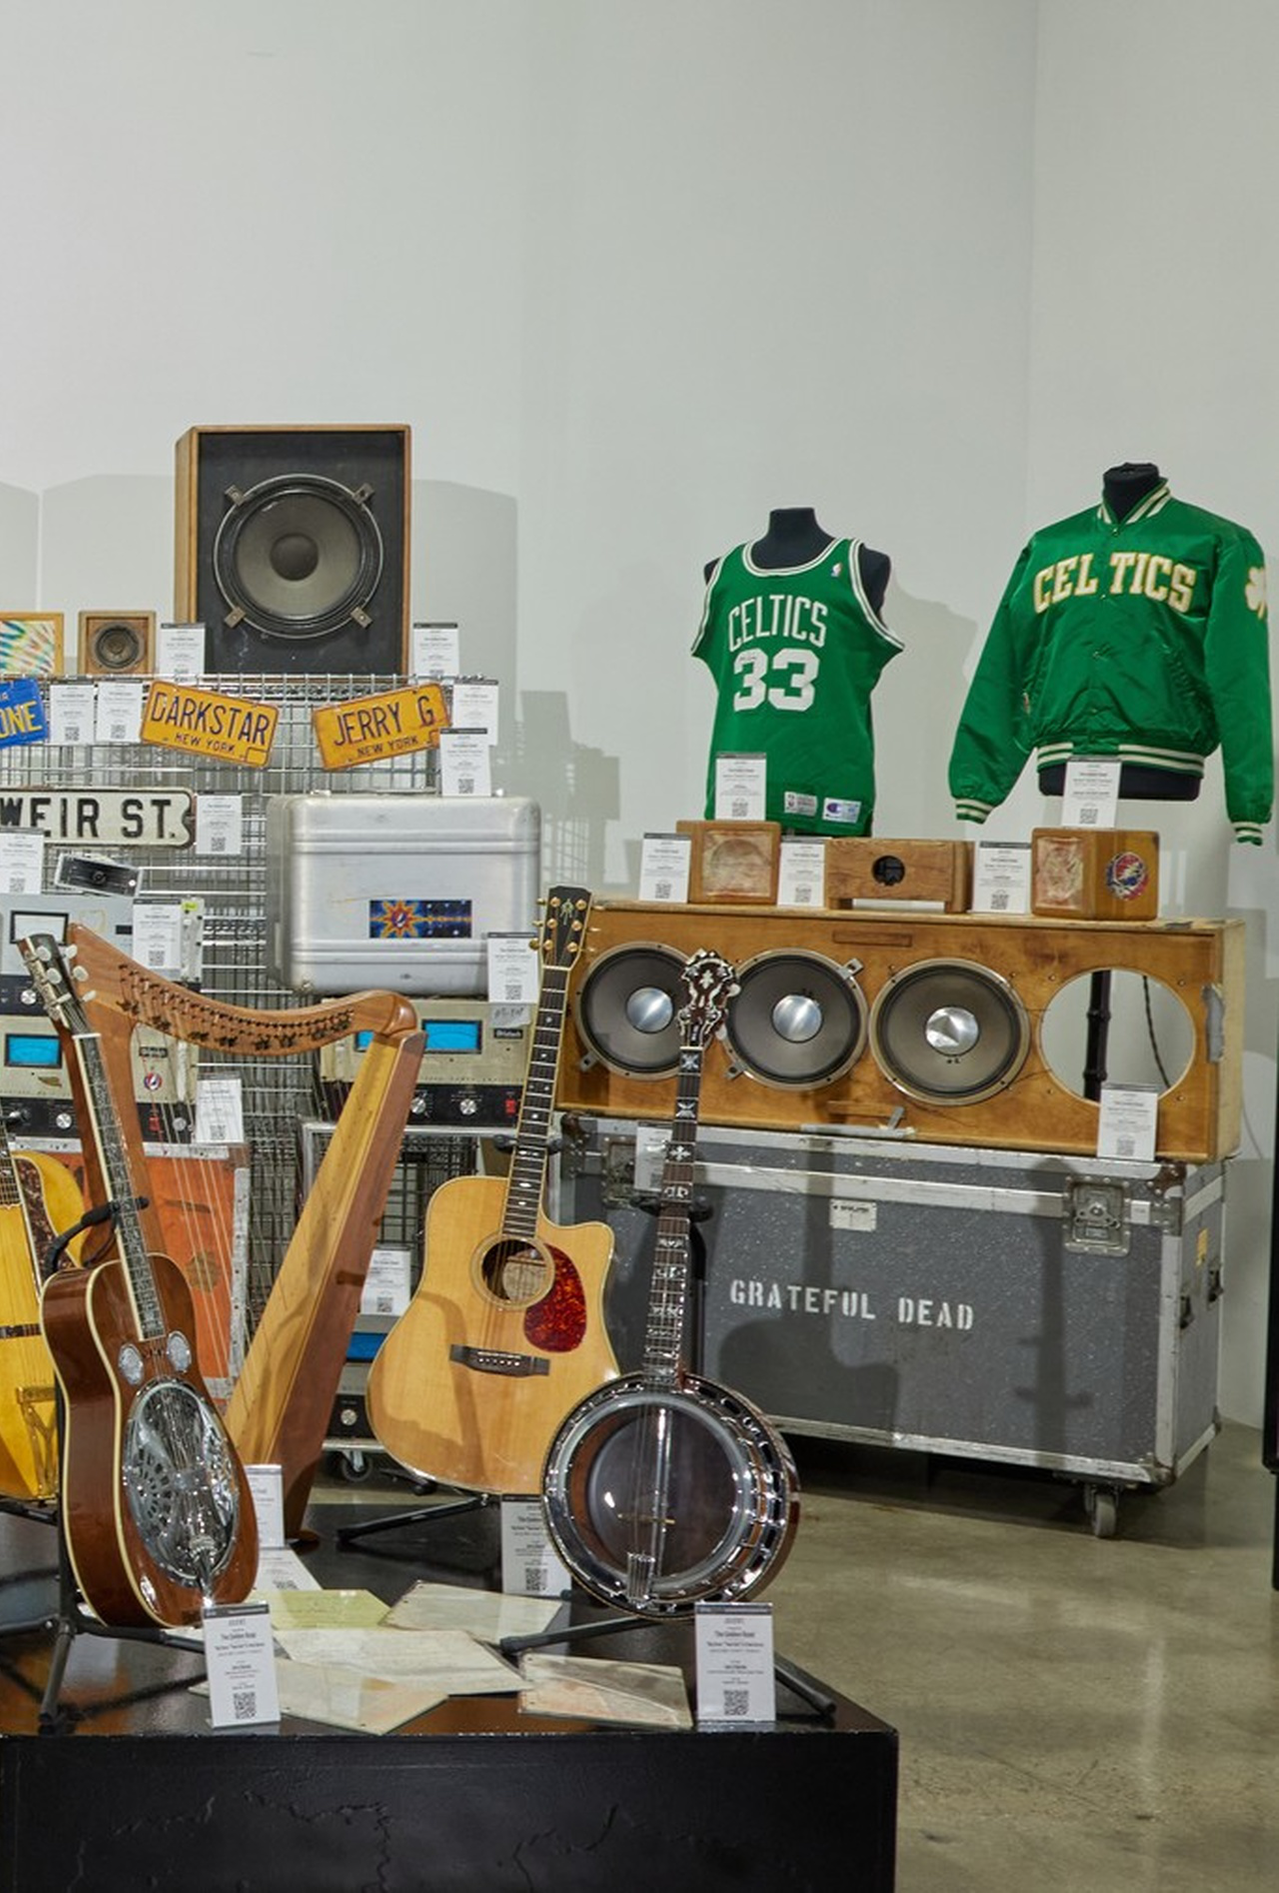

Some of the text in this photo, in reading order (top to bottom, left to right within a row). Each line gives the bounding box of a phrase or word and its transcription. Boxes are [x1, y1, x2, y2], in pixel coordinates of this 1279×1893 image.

[727, 594, 828, 652] CELTICS
[733, 647, 820, 712] 33
[150, 691, 270, 746] DARKSTAR
[175, 732, 236, 752] NEW YORK
[334, 695, 435, 746] JERRY G
[357, 736, 419, 757] NEW YORK
[121, 798, 176, 839] ST.
[729, 1279, 974, 1330] GRATEFUL DEAD
